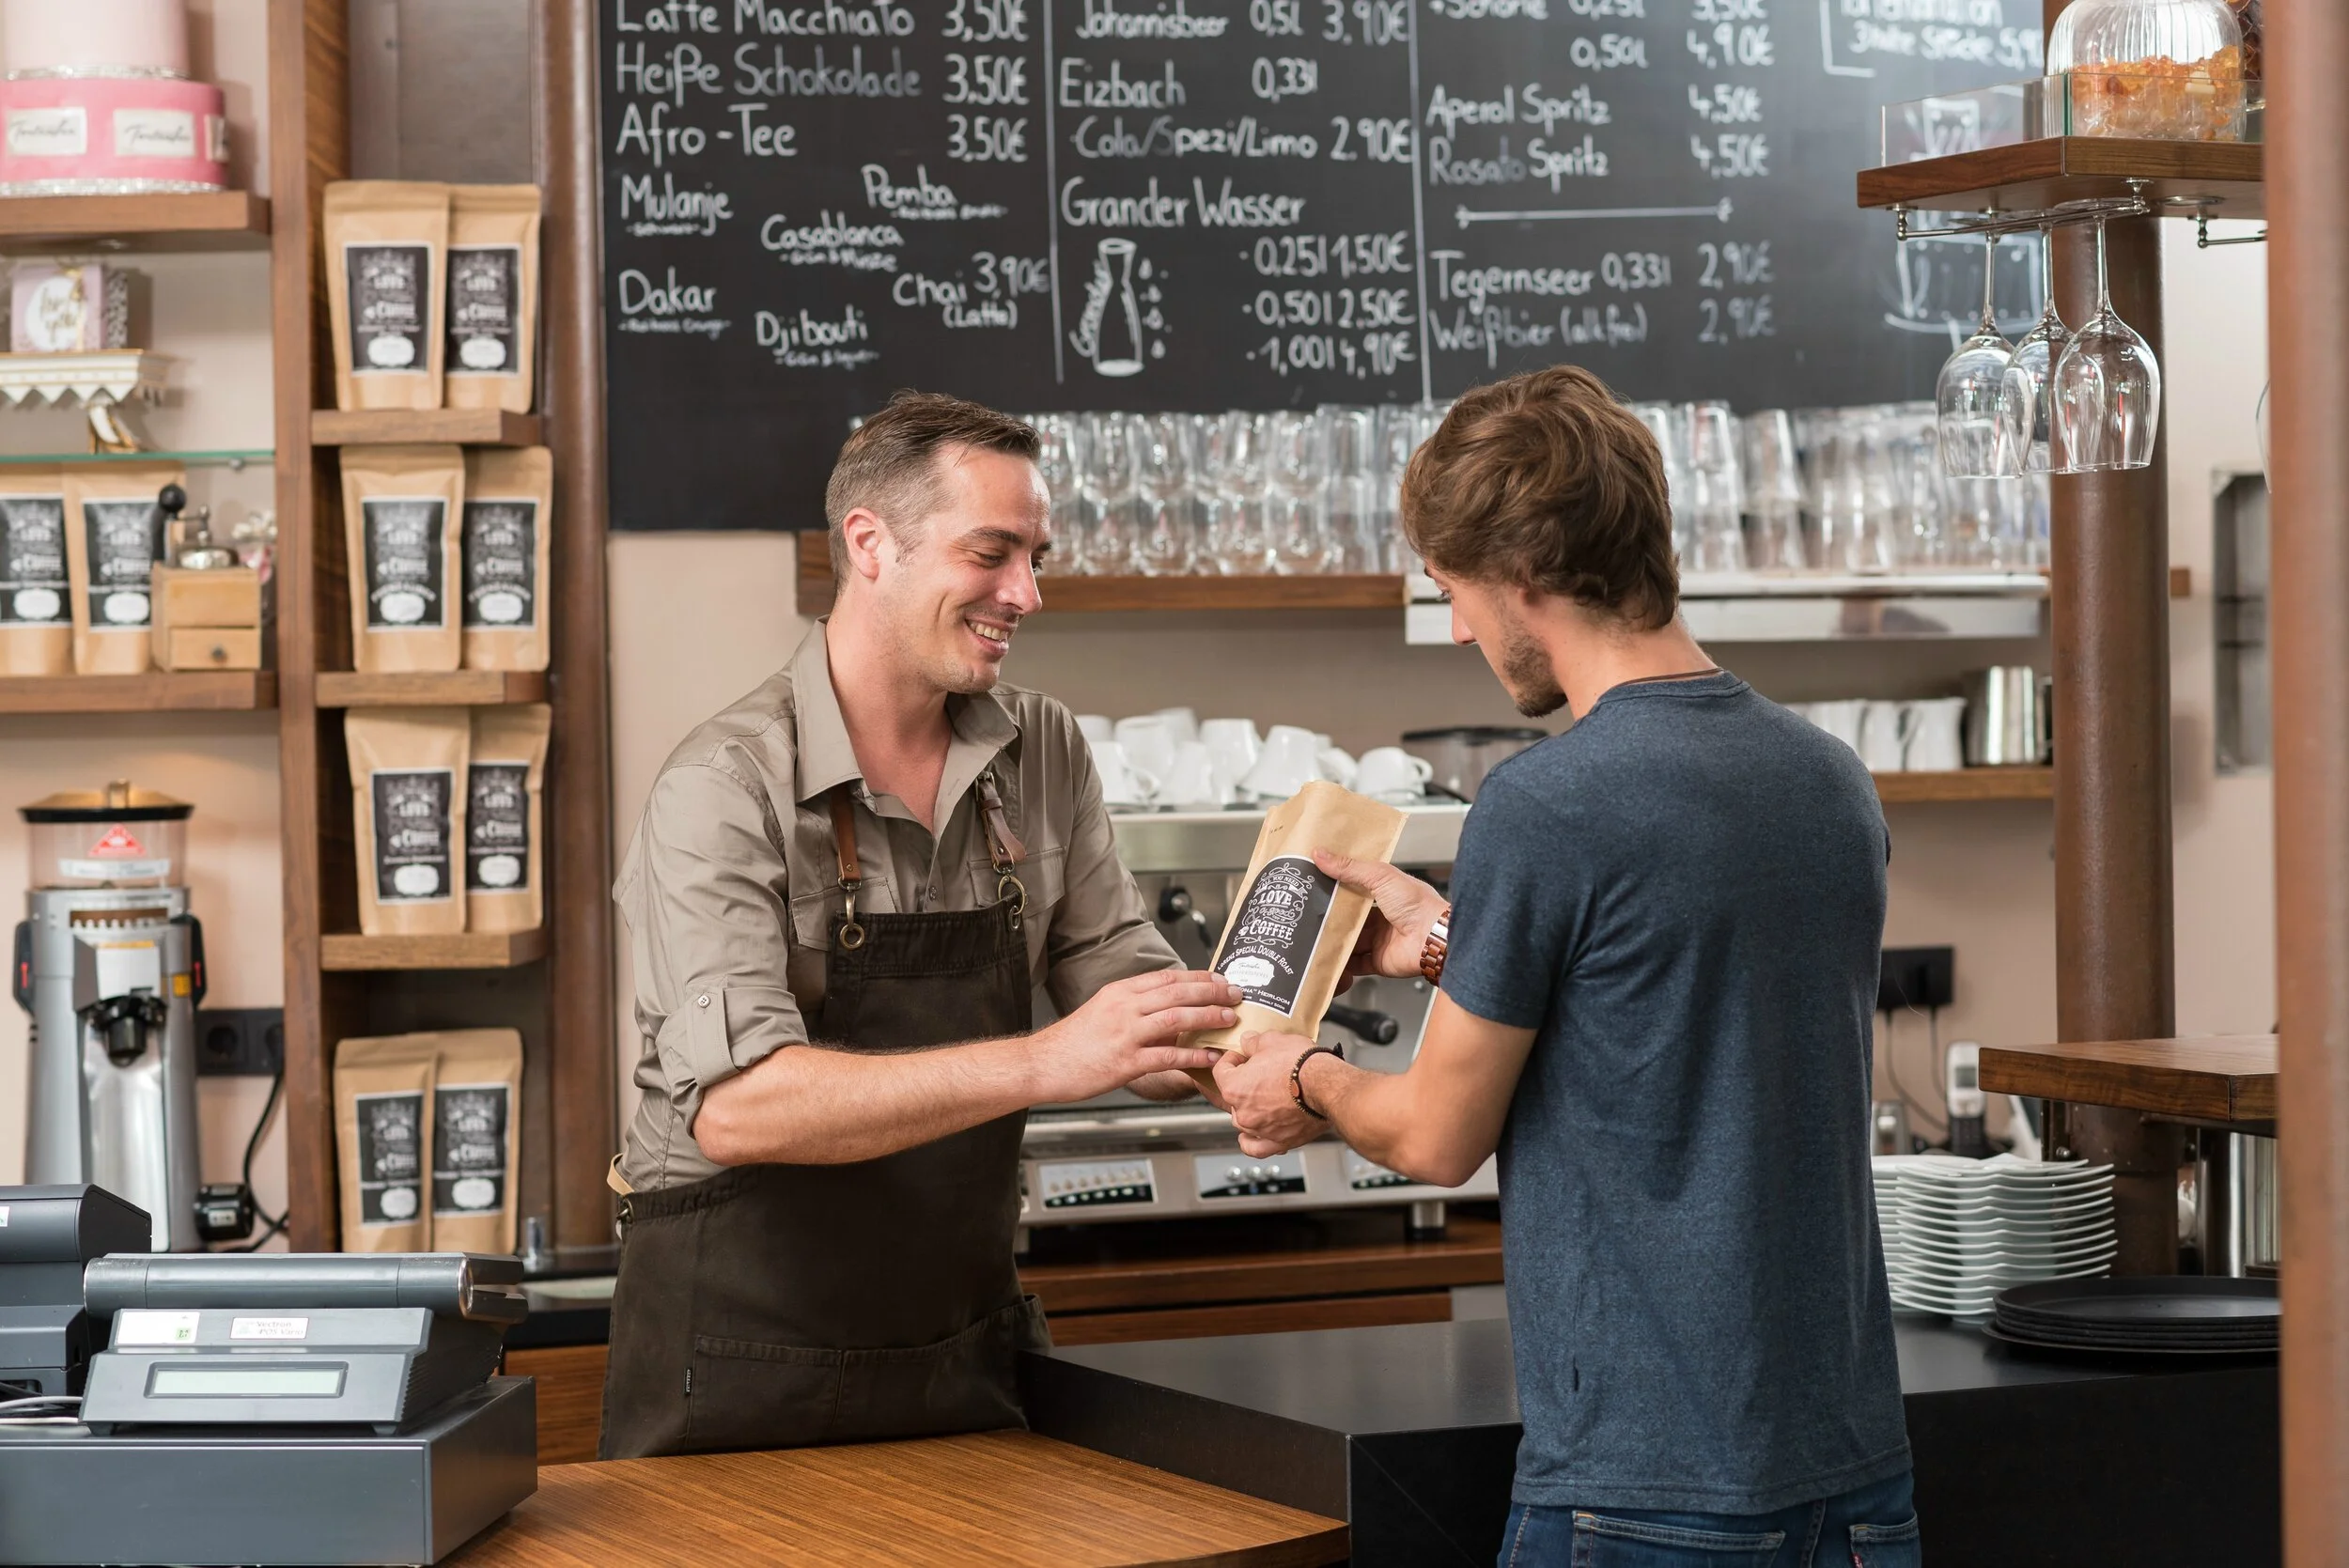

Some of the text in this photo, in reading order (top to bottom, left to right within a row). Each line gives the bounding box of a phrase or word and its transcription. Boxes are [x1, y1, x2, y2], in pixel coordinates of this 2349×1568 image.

[734, 41, 923, 98] Schokolade
[1425, 85, 1516, 140] Aperol
[1520, 83, 1611, 137] Spritz
[861, 163, 958, 209] Pemba
[1527, 133, 1610, 194] Spritz
[1061, 176, 1307, 227] Grander Wasser
[760, 209, 905, 251] Casablanca
[618, 264, 717, 315] Dakar
[893, 270, 967, 306] Chai
[1428, 249, 1595, 316] Tegernseer
[754, 304, 868, 356] Djibouti
[1257, 890, 1293, 907] LOVE
[1284, 876, 1299, 887] NEED
[1249, 919, 1294, 940] COFFEE
